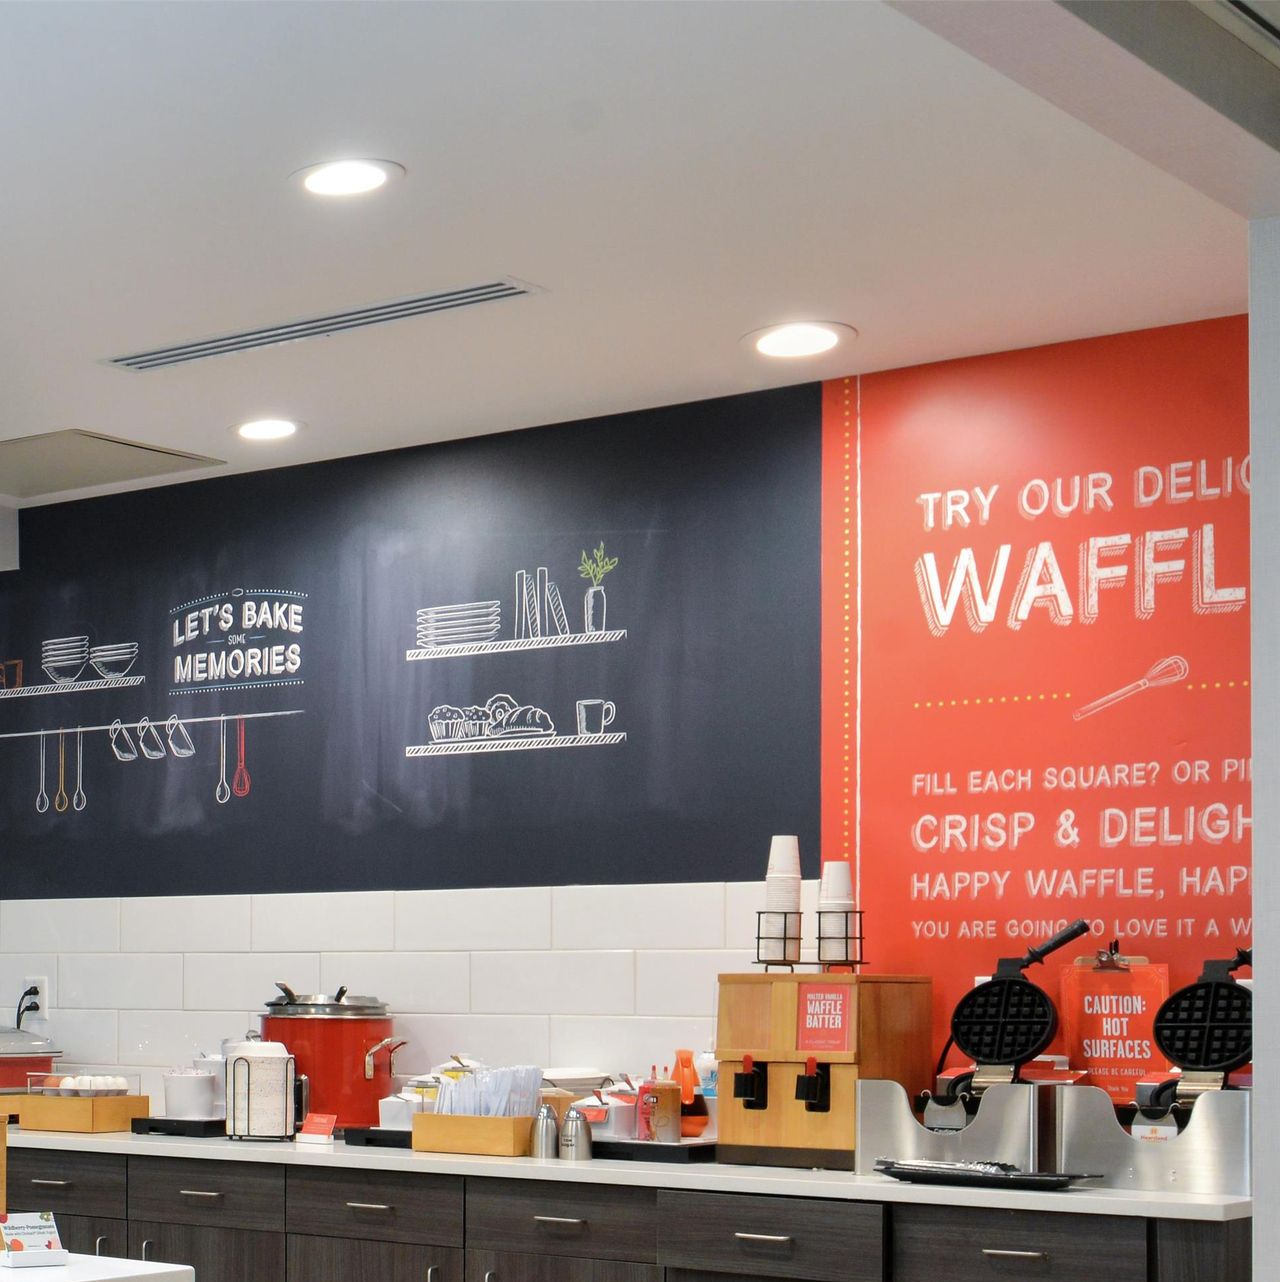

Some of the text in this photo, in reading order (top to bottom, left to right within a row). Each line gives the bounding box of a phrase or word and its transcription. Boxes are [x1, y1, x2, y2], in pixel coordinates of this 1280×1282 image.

[916, 484, 999, 532] TRY
[1018, 472, 1114, 520] OUR
[914, 523, 1247, 637] WAFFL
[172, 600, 304, 647] LET'S BAKE
[227, 633, 246, 646] SOME
[174, 643, 301, 683] MEMORIES
[912, 772, 958, 796] FILL
[967, 769, 1032, 794] EACH
[1043, 761, 1160, 790] SQUARE?
[1173, 760, 1210, 784] OR
[912, 811, 1036, 853] CRISP
[1055, 808, 1080, 849] &
[911, 870, 1012, 900] HAPPY
[1025, 867, 1165, 900] WAFFLE,
[912, 920, 950, 939] YOU
[956, 919, 998, 938] ARE
[1114, 918, 1168, 937] LOVE
[1176, 917, 1196, 937] IT
[1204, 917, 1220, 938] A
[807, 1000, 843, 1015] WAFFLE
[1083, 994, 1146, 1015] CAUTION:
[806, 1014, 842, 1029] BATTER
[1102, 1017, 1129, 1037] HOT
[1083, 1039, 1152, 1059] SURFACES
[1088, 1066, 1109, 1076] PLEASE
[1111, 1067, 1118, 1076] BE
